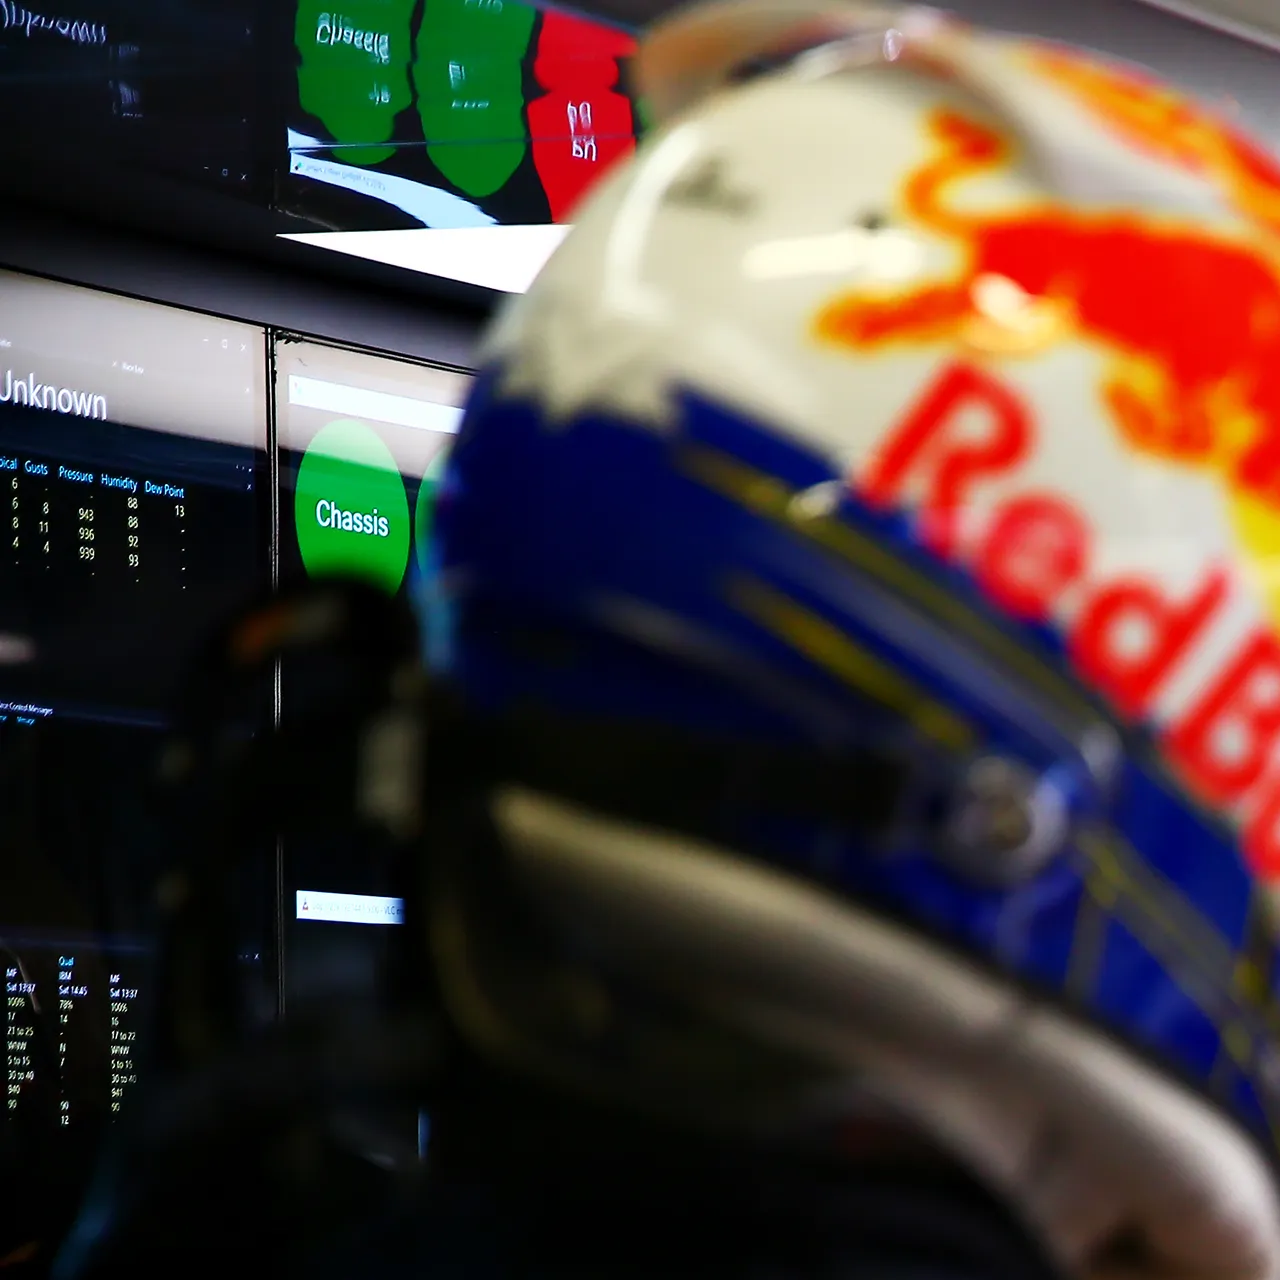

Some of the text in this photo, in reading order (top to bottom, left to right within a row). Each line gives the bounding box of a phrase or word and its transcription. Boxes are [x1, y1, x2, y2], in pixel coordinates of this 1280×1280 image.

[24, 460, 48, 475] Gusts
[58, 466, 94, 483] Pressure
[101, 473, 139, 493] Humidity
[145, 481, 163, 495] Dew
[164, 484, 185, 498] Point
[175, 505, 185, 517] 13
[316, 499, 389, 538] Chassis
[856, 360, 1240, 725] Red
